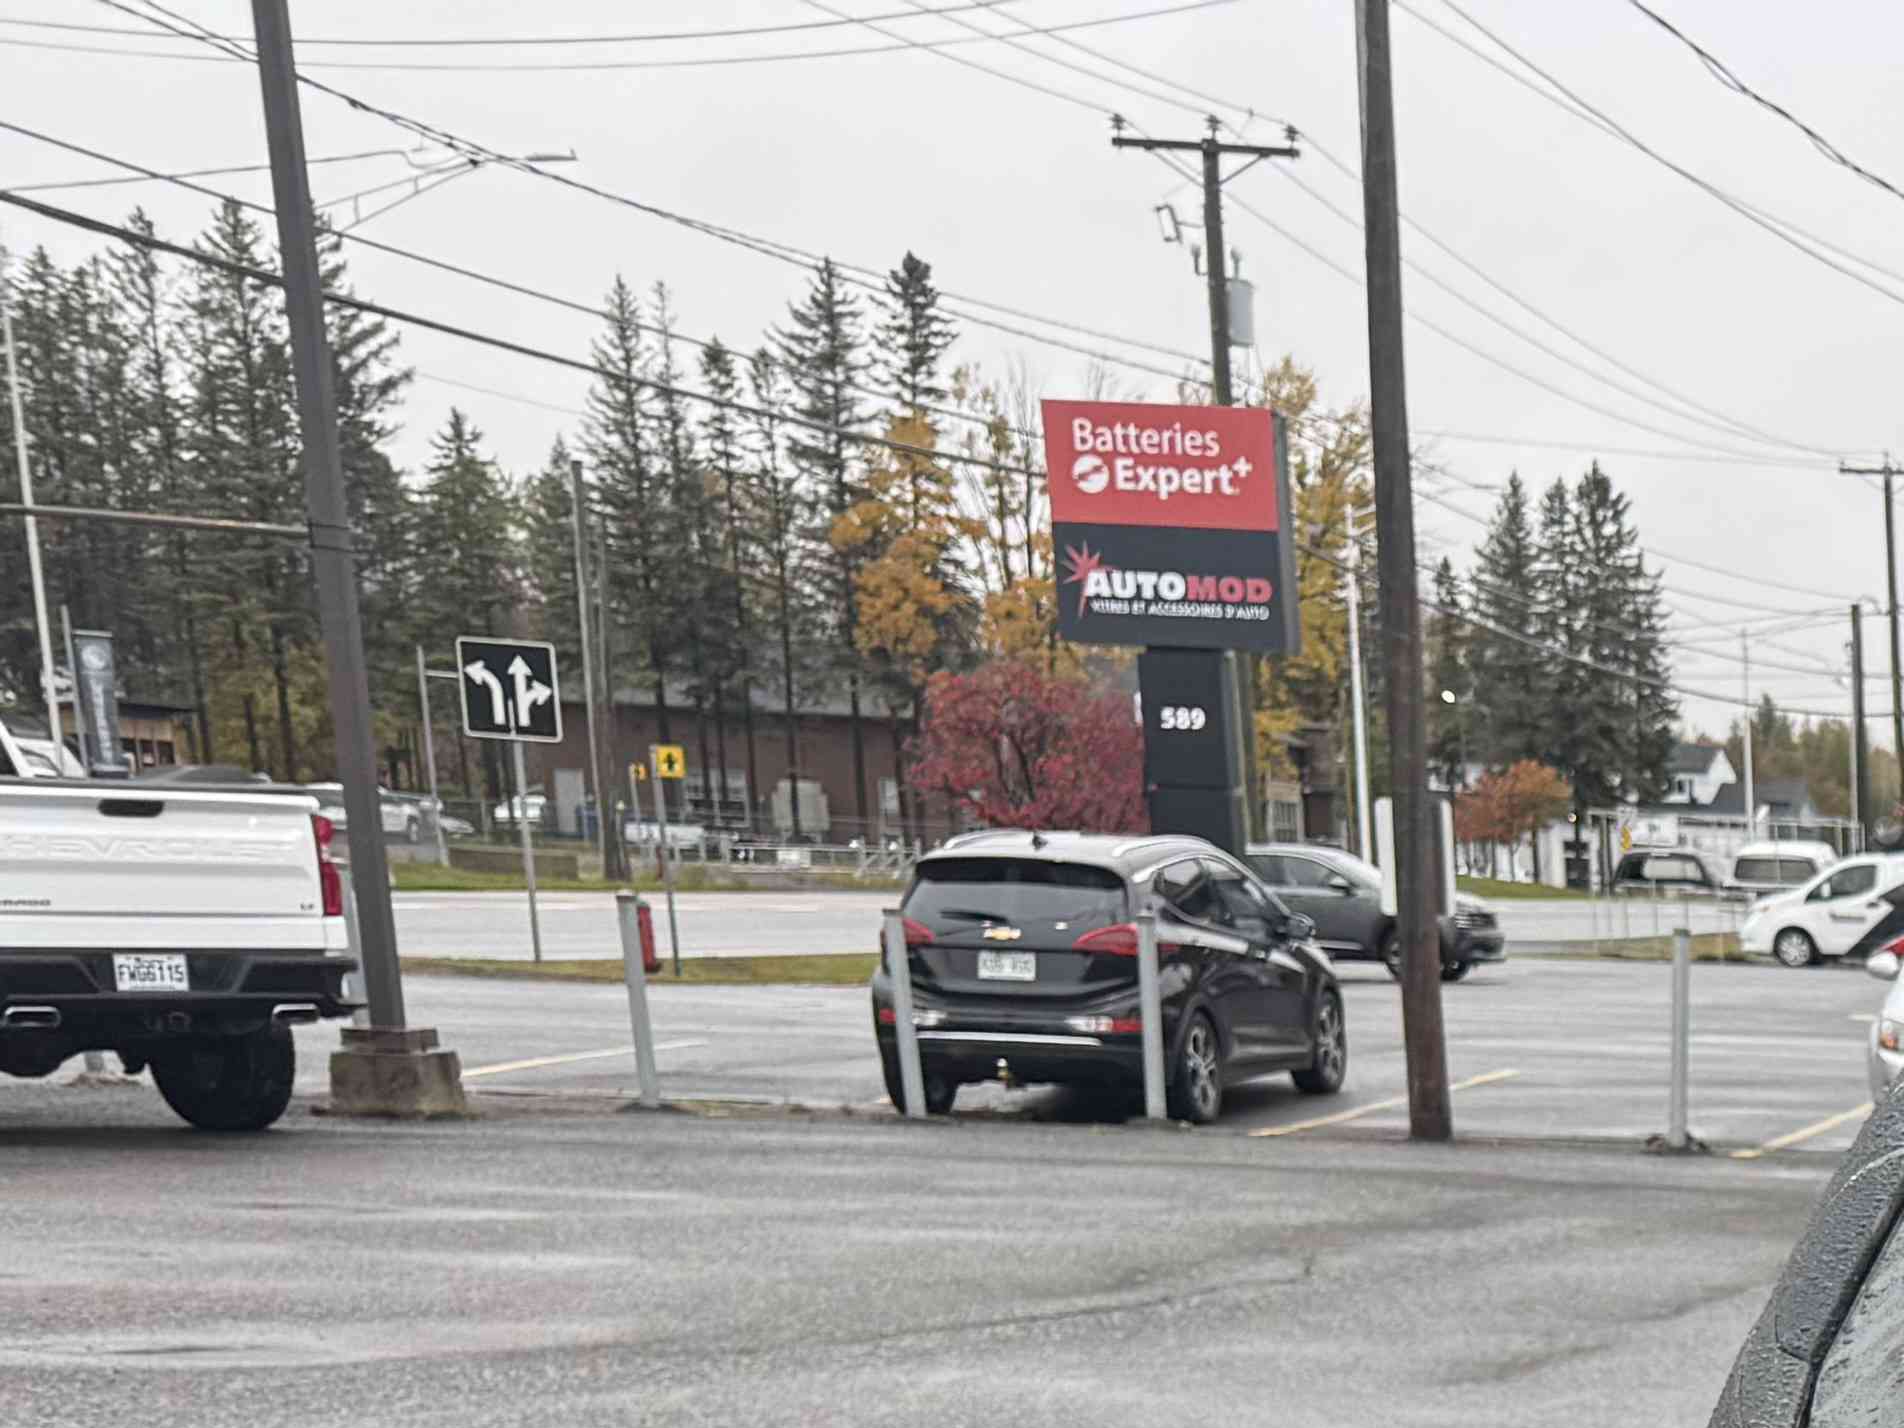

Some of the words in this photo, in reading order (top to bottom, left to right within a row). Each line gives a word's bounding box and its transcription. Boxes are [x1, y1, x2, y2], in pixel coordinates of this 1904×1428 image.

[1072, 417, 1221, 457] Batteries
[1086, 569, 1273, 604] AUTOMOD
[1160, 706, 1206, 730] 589
